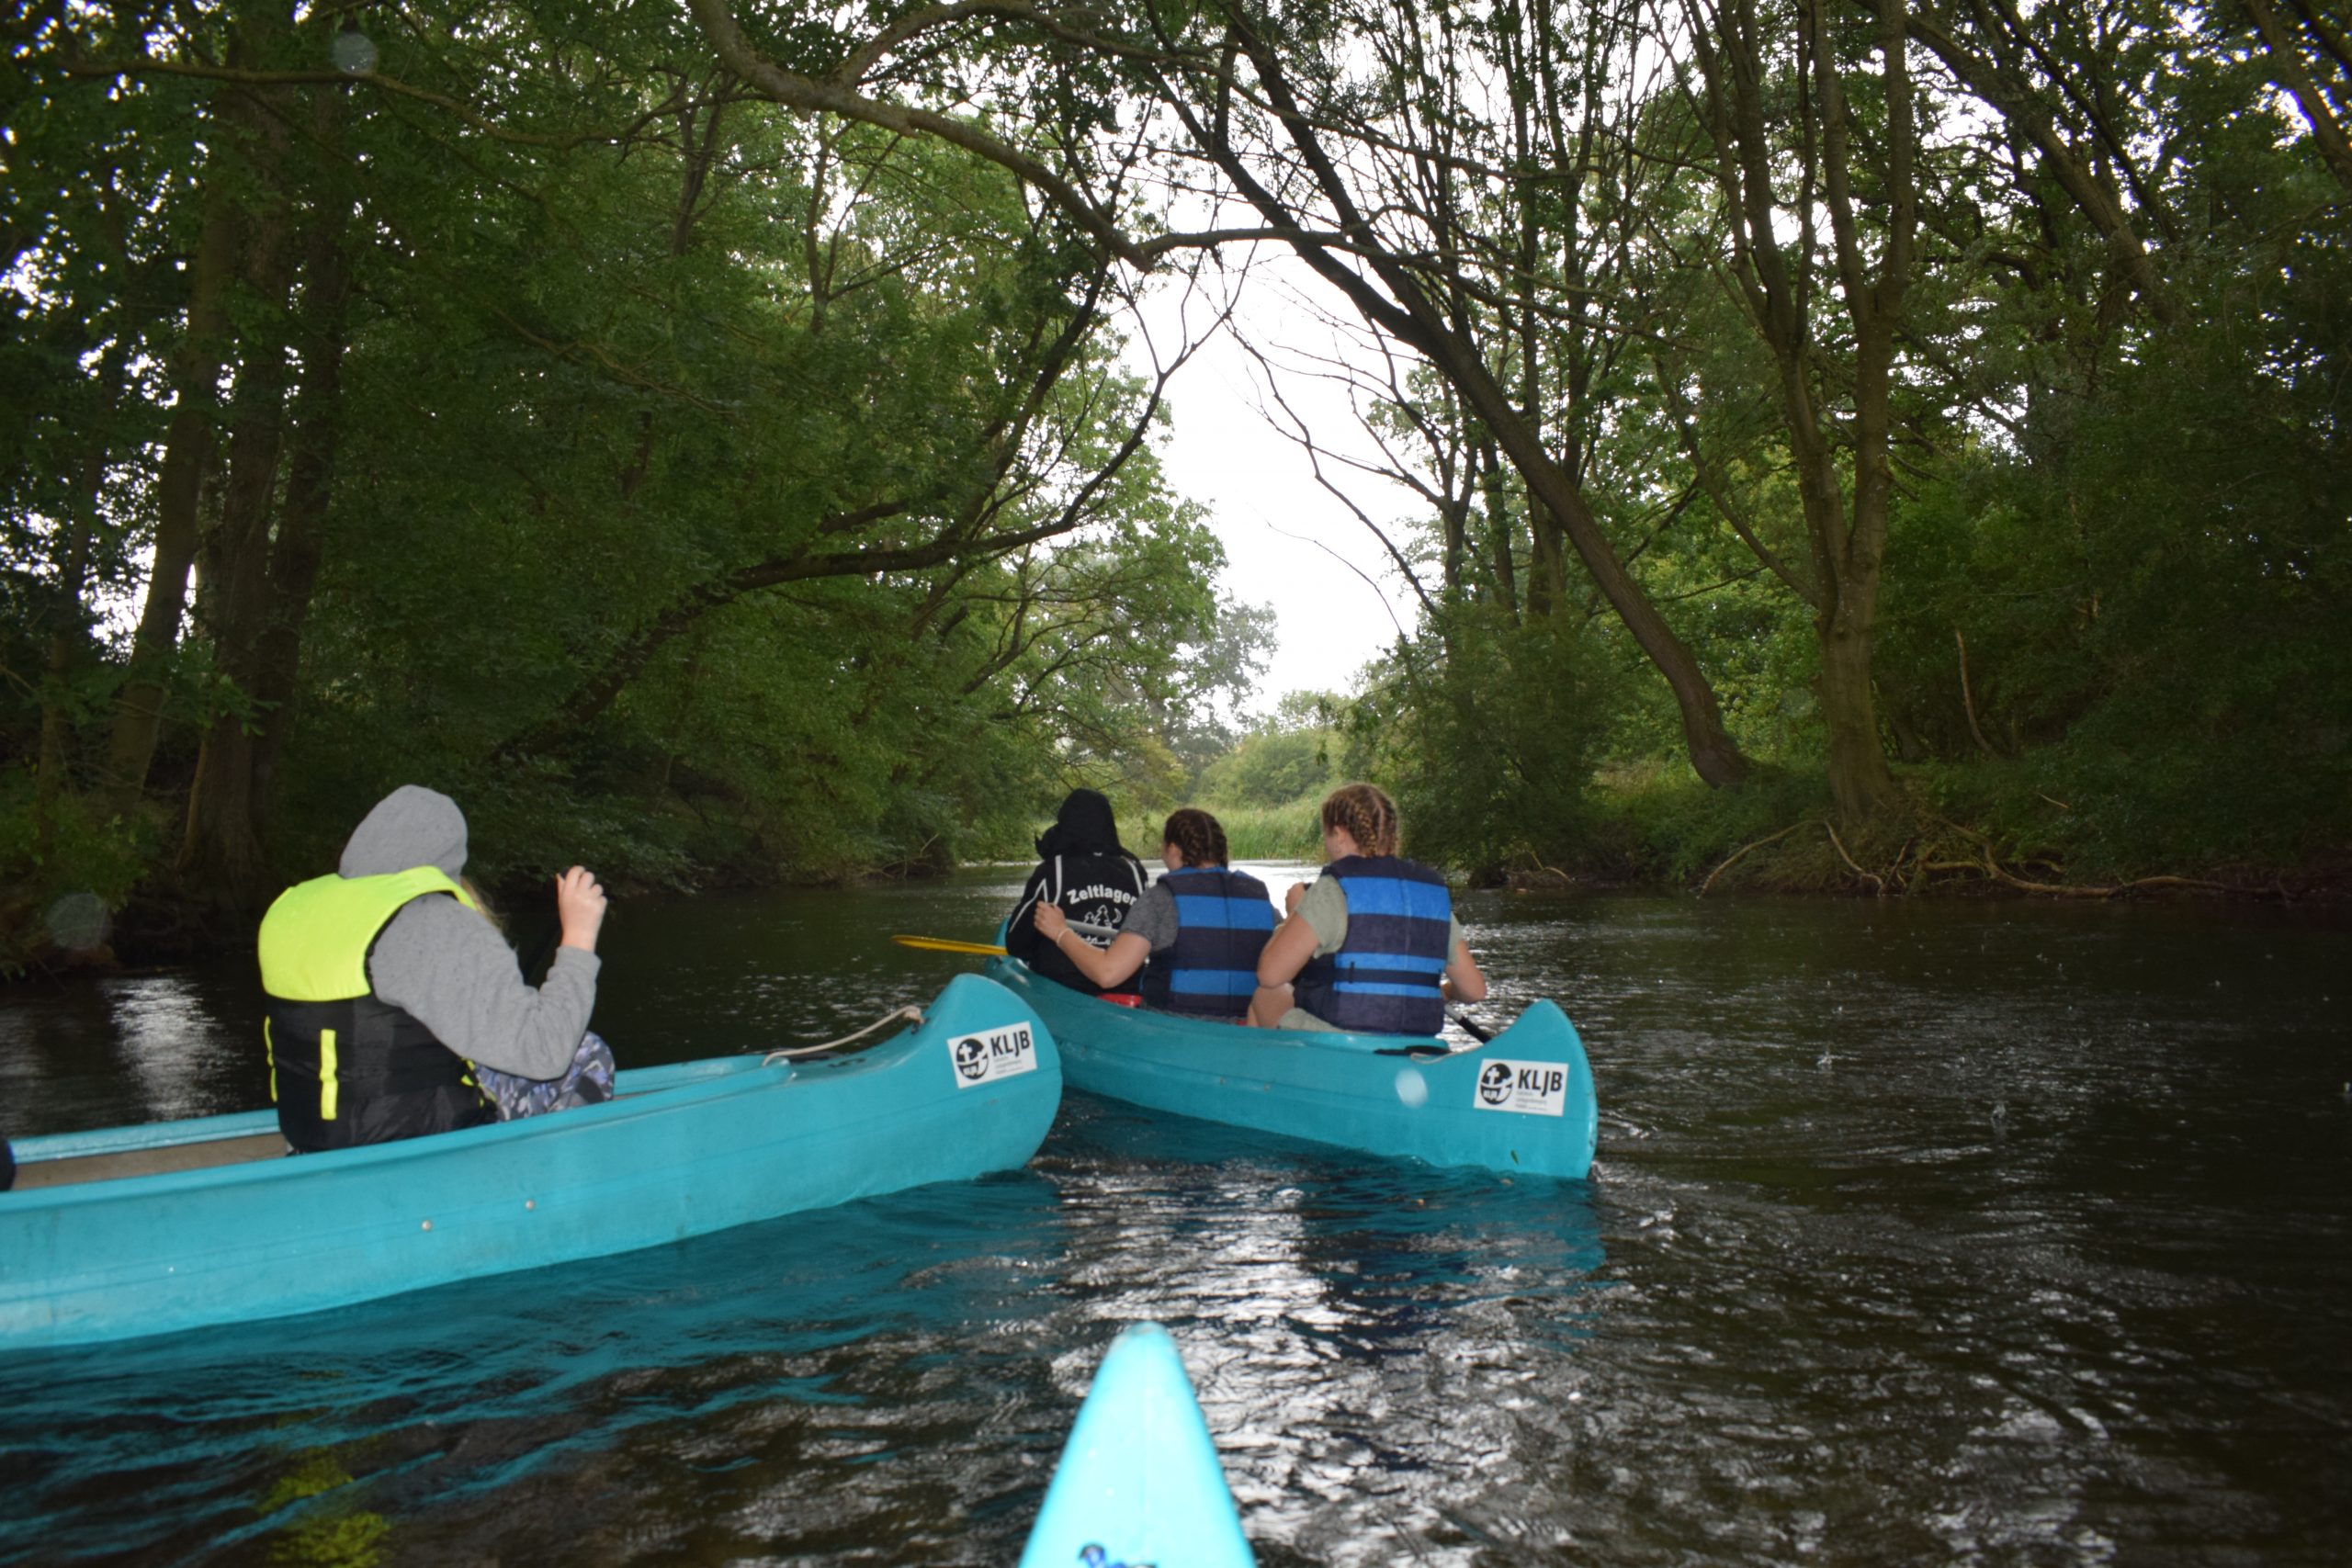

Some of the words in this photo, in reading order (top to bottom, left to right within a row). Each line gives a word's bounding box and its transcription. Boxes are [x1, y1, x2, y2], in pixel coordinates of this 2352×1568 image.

[1067, 884, 1137, 906] Zeltlager
[990, 1030, 1031, 1057] KLJB
[1518, 1068, 1563, 1097] KLJB
